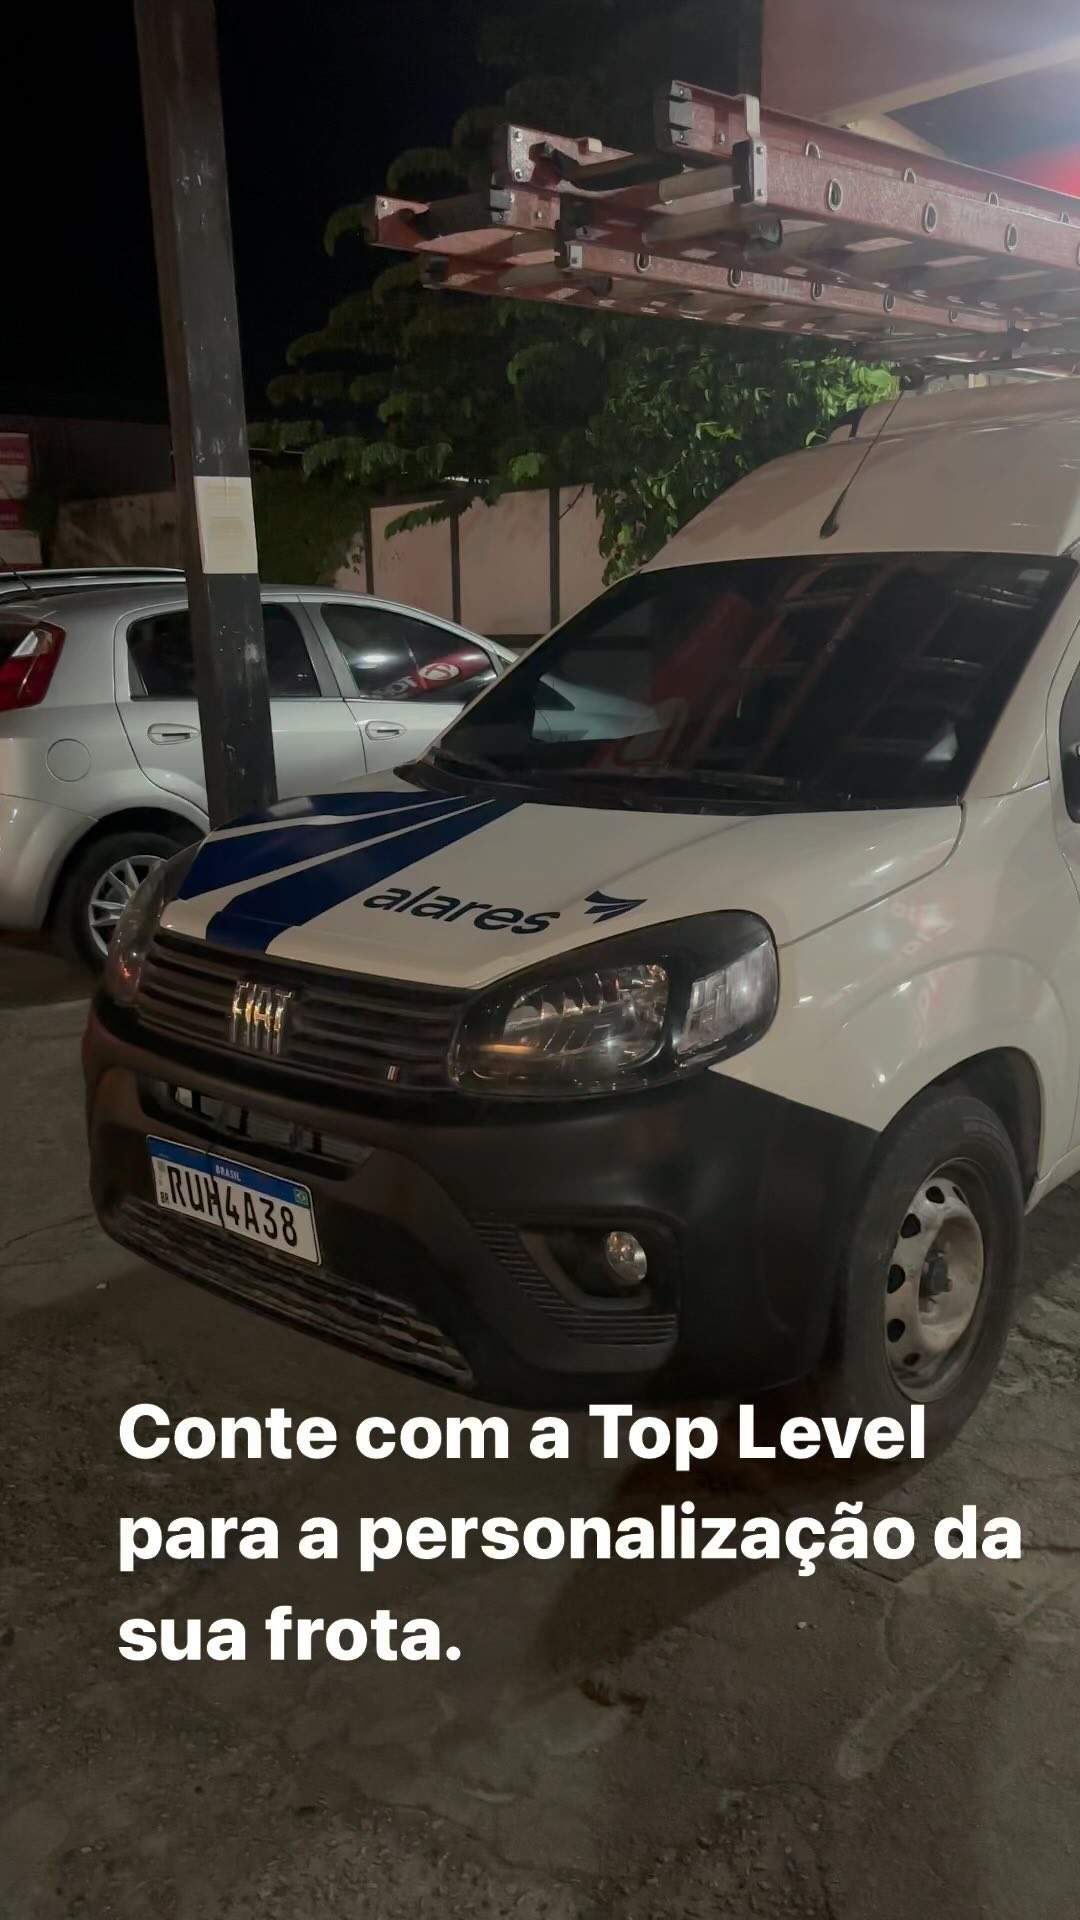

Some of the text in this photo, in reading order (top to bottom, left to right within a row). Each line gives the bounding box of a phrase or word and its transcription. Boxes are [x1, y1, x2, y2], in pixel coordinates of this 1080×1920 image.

[362, 885, 561, 935] alares
[215, 1163, 242, 1182] BRASIL
[166, 1165, 298, 1247] RUH4A38
